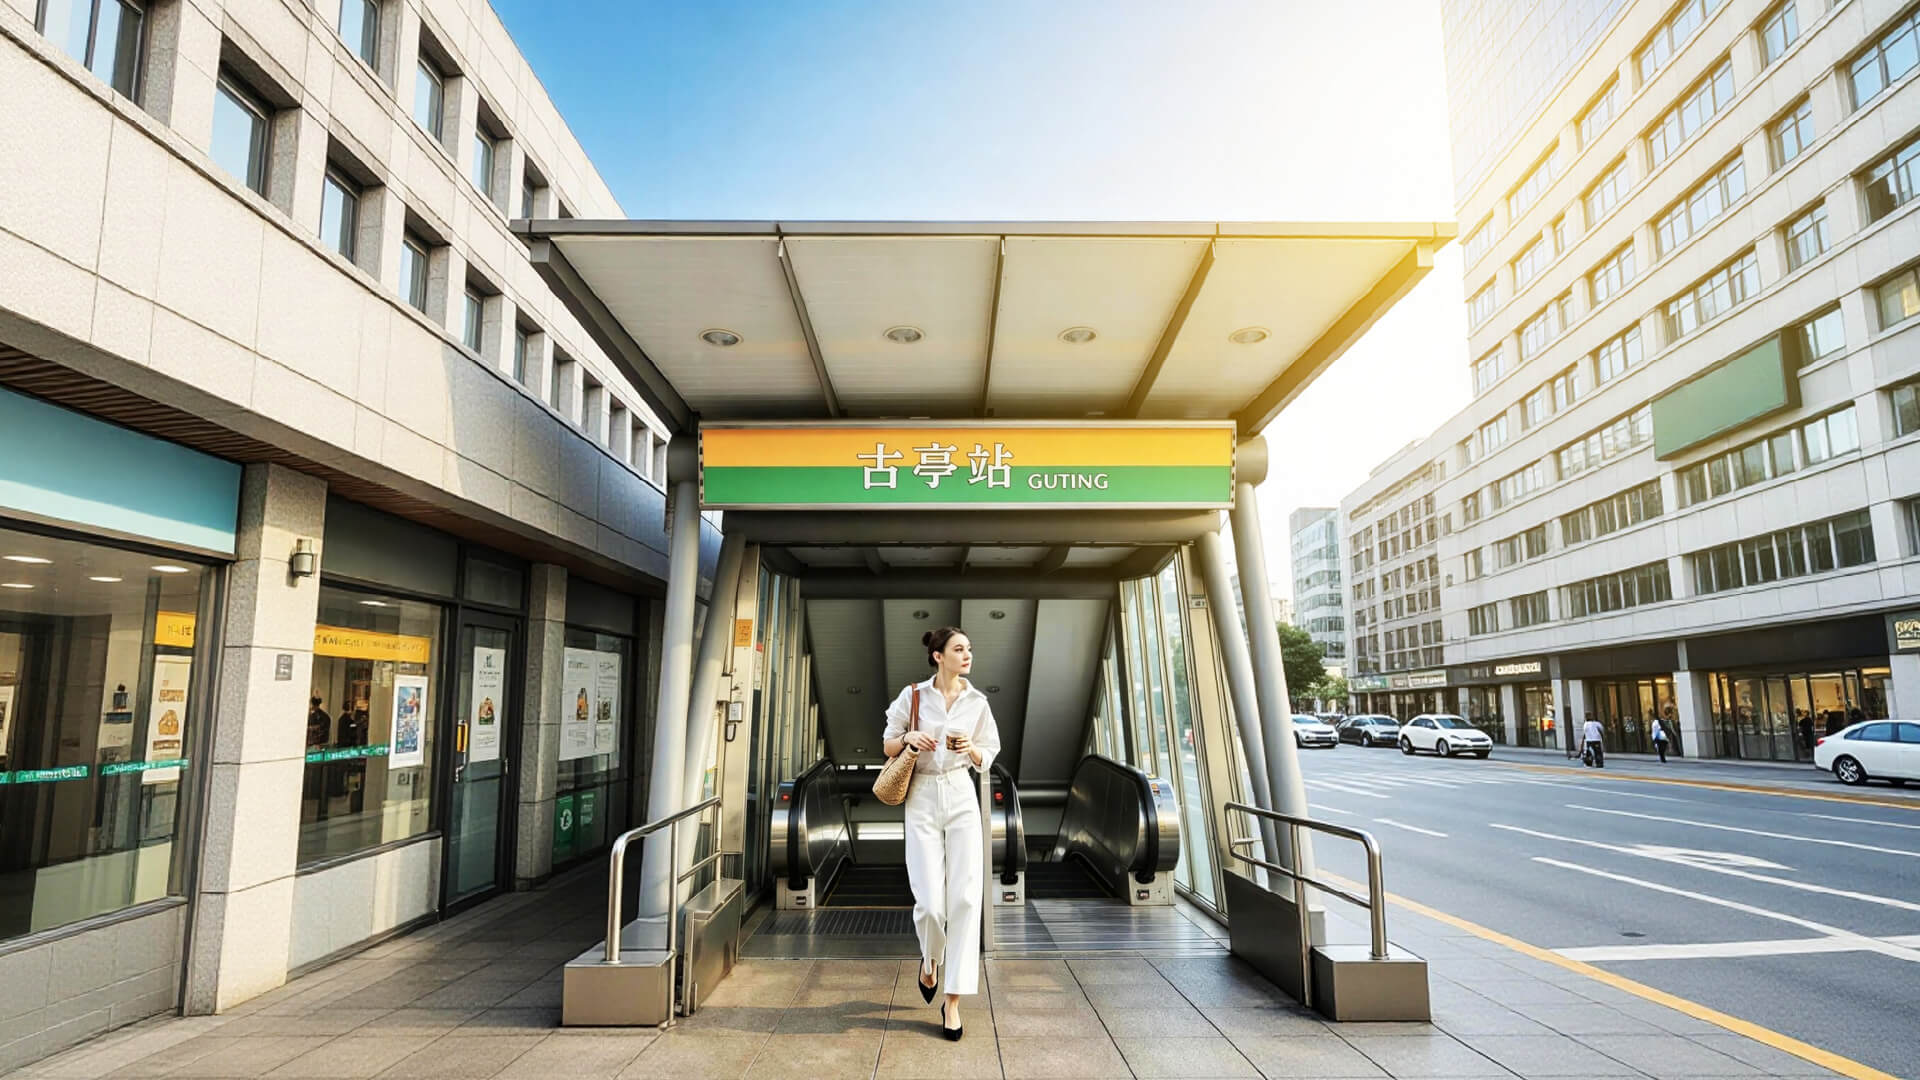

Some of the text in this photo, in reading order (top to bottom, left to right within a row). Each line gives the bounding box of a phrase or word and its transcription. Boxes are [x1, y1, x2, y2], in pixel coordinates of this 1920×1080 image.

[856, 442, 1014, 490] 古亭站
[1027, 473, 1109, 490] GUTING
